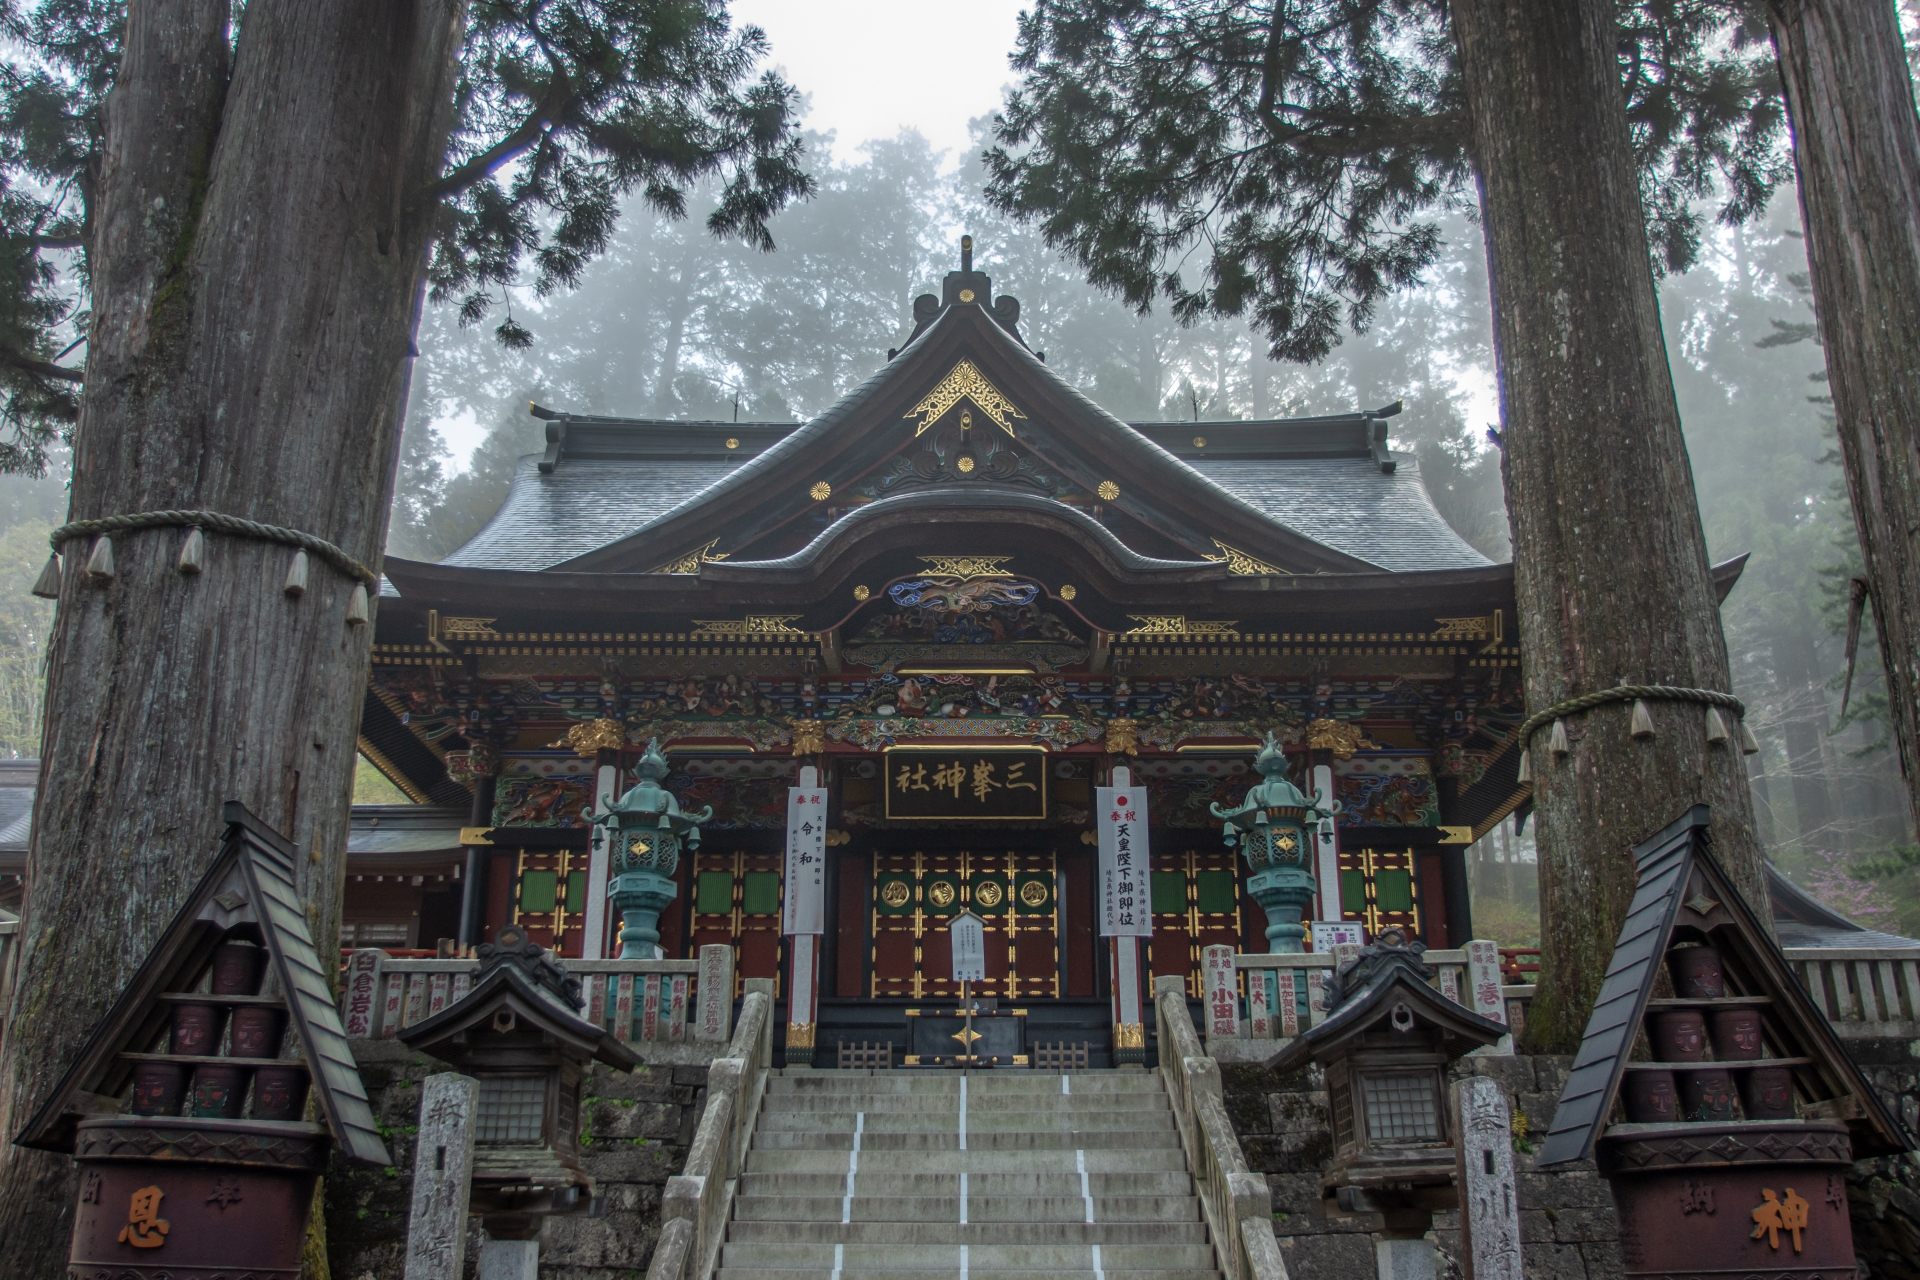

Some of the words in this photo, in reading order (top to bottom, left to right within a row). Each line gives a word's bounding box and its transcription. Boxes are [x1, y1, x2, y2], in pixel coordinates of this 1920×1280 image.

[797, 795, 820, 804] 奉祝
[895, 759, 1037, 802] 三峯神社
[799, 821, 814, 865] 令和
[1110, 810, 1136, 822] 奉祝
[814, 816, 822, 884] 天皇陛下御即位
[1116, 823, 1134, 926] 天皇陛下御即位
[1138, 869, 1147, 926] 埼玉県神社庁
[348, 951, 377, 1035] 臼倉岩松
[118, 1185, 170, 1249] 恩
[1750, 1187, 1810, 1252] 神
